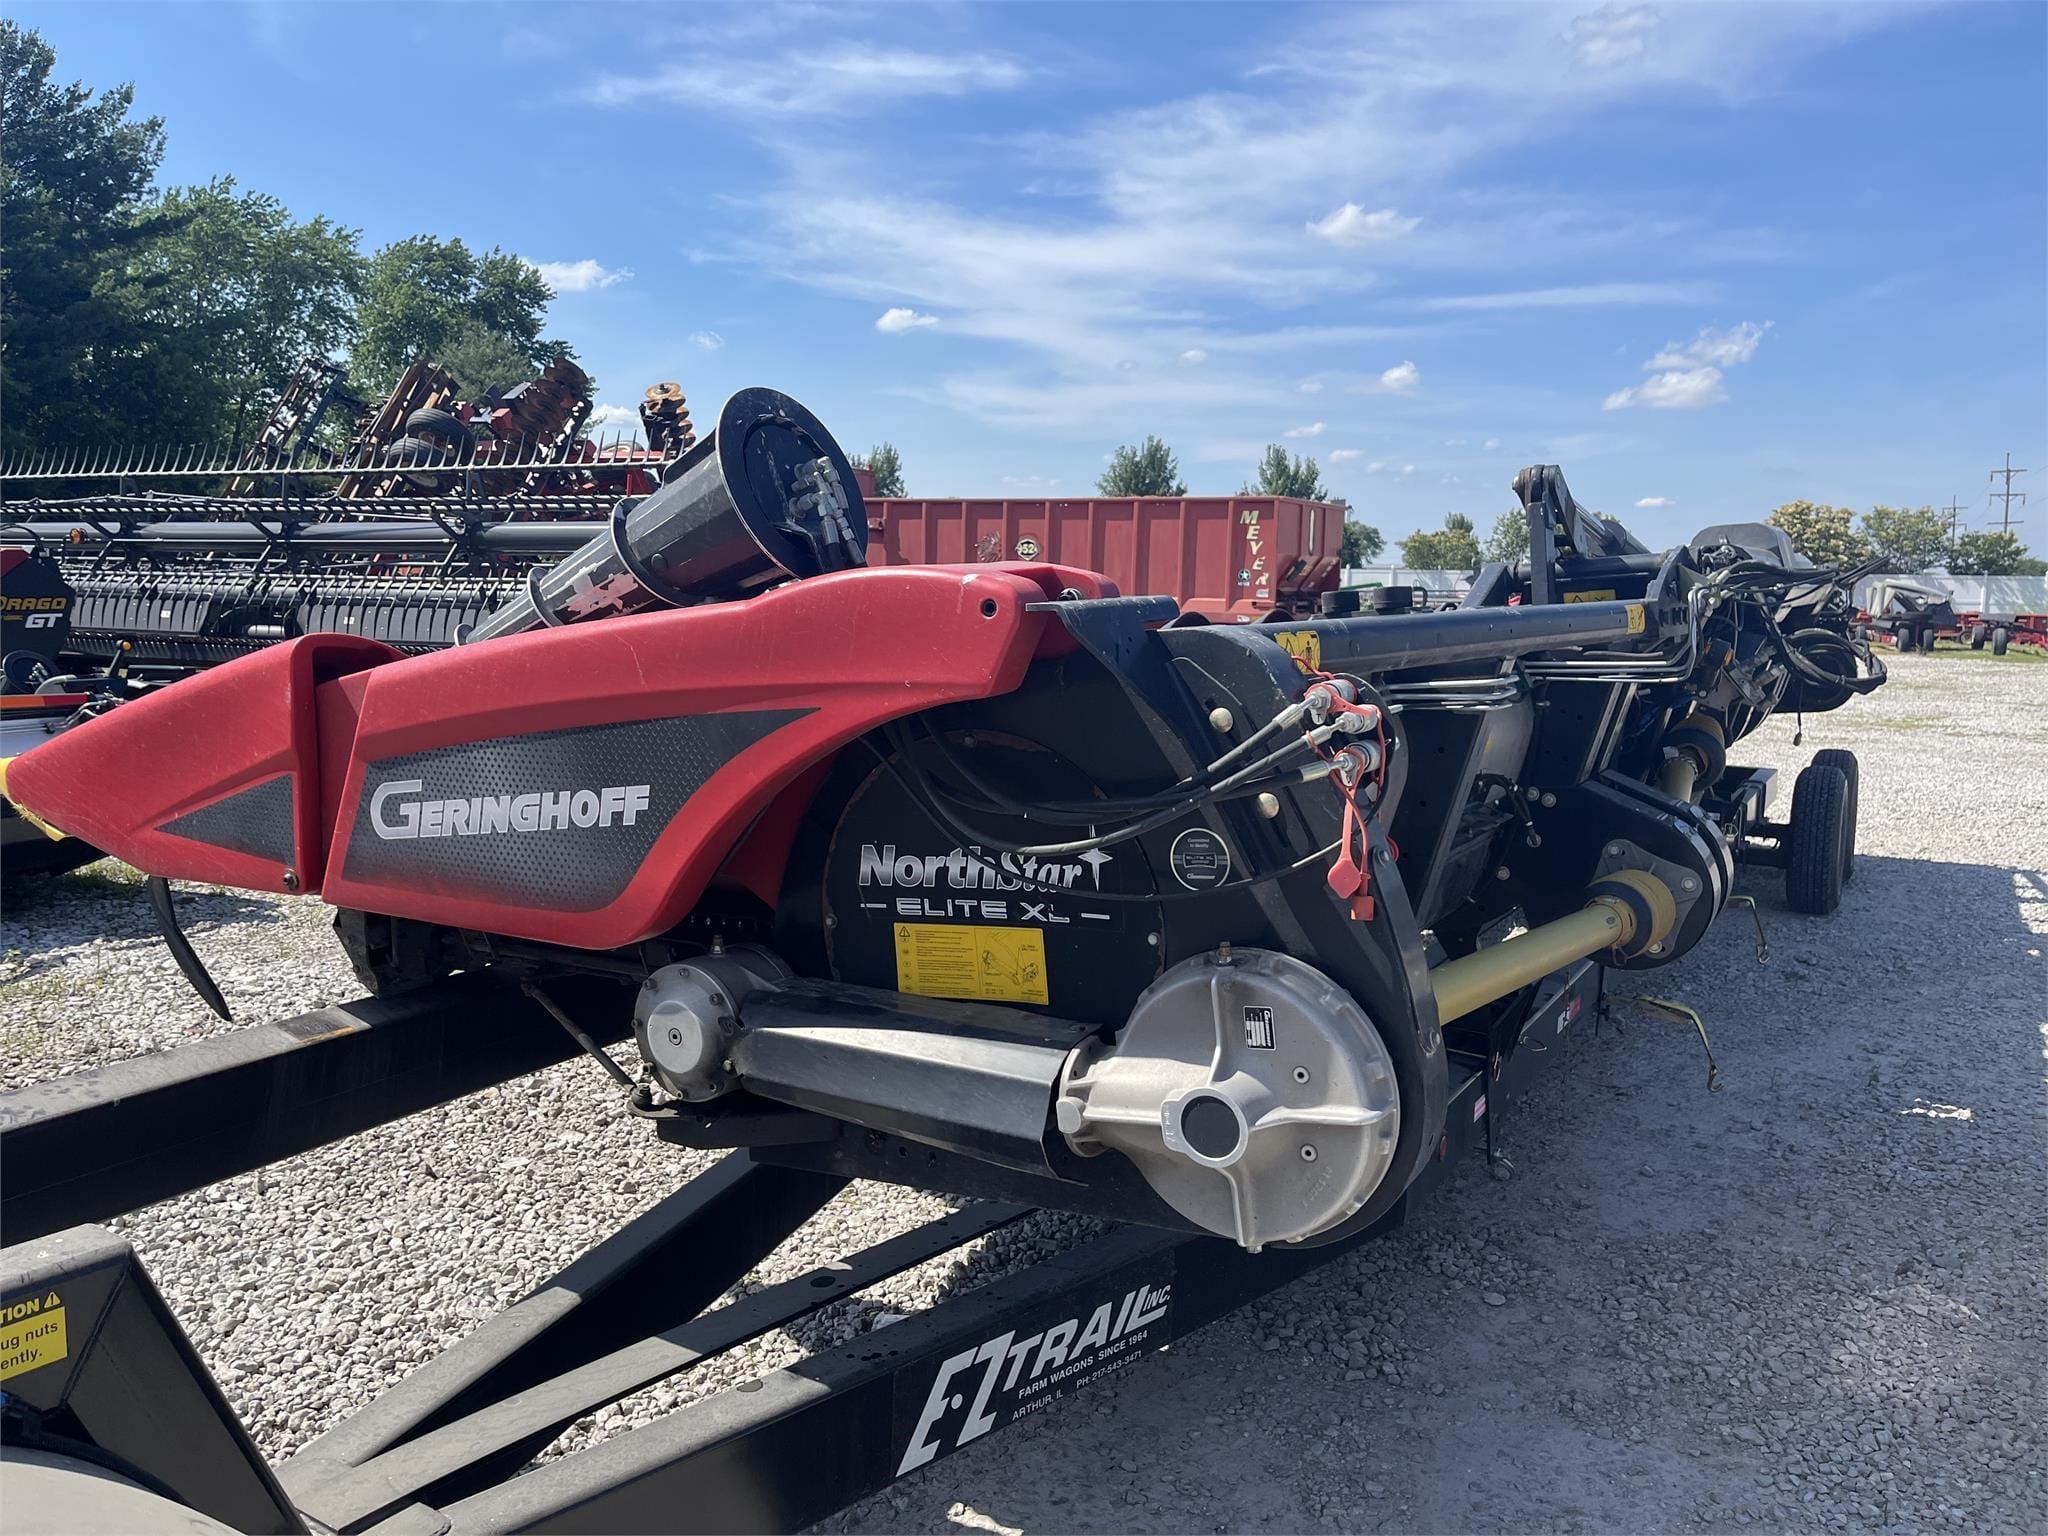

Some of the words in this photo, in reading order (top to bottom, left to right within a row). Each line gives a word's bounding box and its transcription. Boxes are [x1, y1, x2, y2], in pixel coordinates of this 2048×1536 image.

[25, 613, 63, 629] GT
[858, 844, 1082, 893] NorthStar
[896, 898, 1008, 919] ELITE
[1019, 902, 1070, 923] XL
[26, 1323, 58, 1342] nuts
[1, 1349, 43, 1370] ently.
[1018, 1377, 1048, 1399] FARM
[1050, 1356, 1094, 1384] WAGONS
[1098, 1339, 1126, 1361] SINCE
[1056, 1389, 1064, 1401] IL
[1091, 1350, 1142, 1382] 217-543-3471
